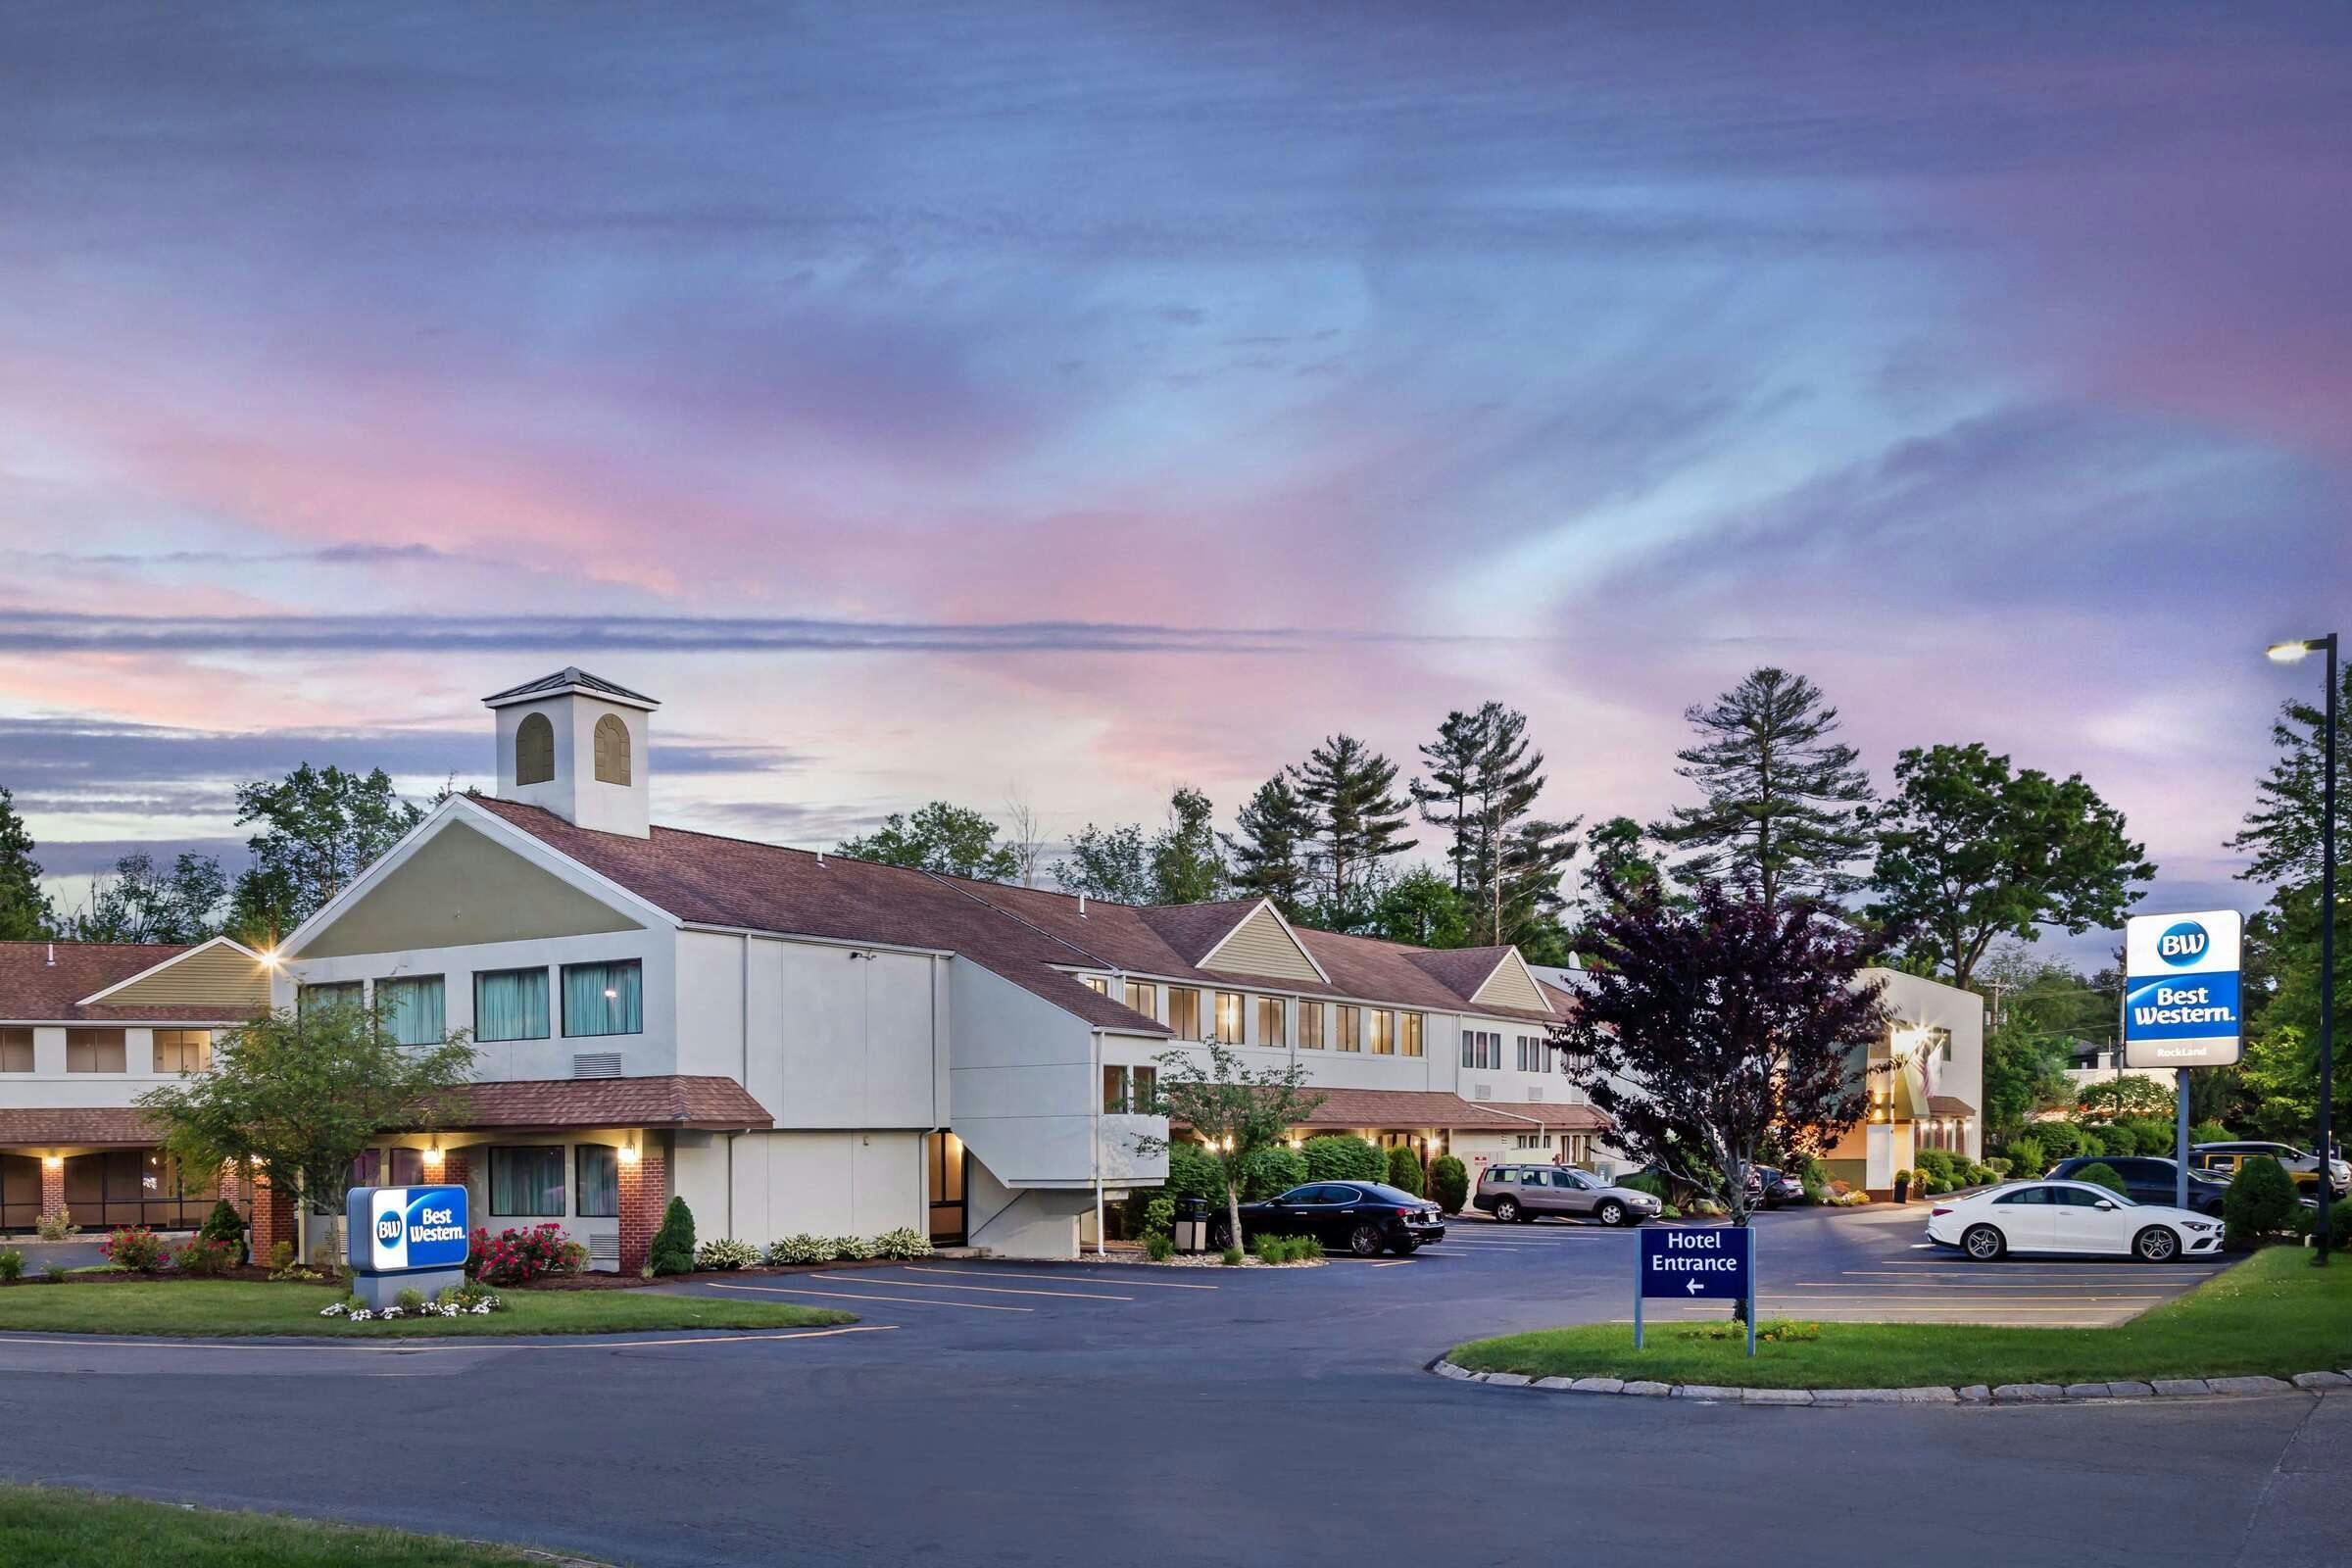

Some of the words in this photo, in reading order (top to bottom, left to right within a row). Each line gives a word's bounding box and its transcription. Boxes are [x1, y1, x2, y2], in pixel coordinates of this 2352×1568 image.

[2162, 934, 2205, 956] BW
[2157, 988, 2209, 1005] Best
[422, 1208, 452, 1225] Best
[378, 1220, 401, 1239] BW
[1668, 1231, 1722, 1249] Hotel
[1652, 1254, 1738, 1271] Entrance
